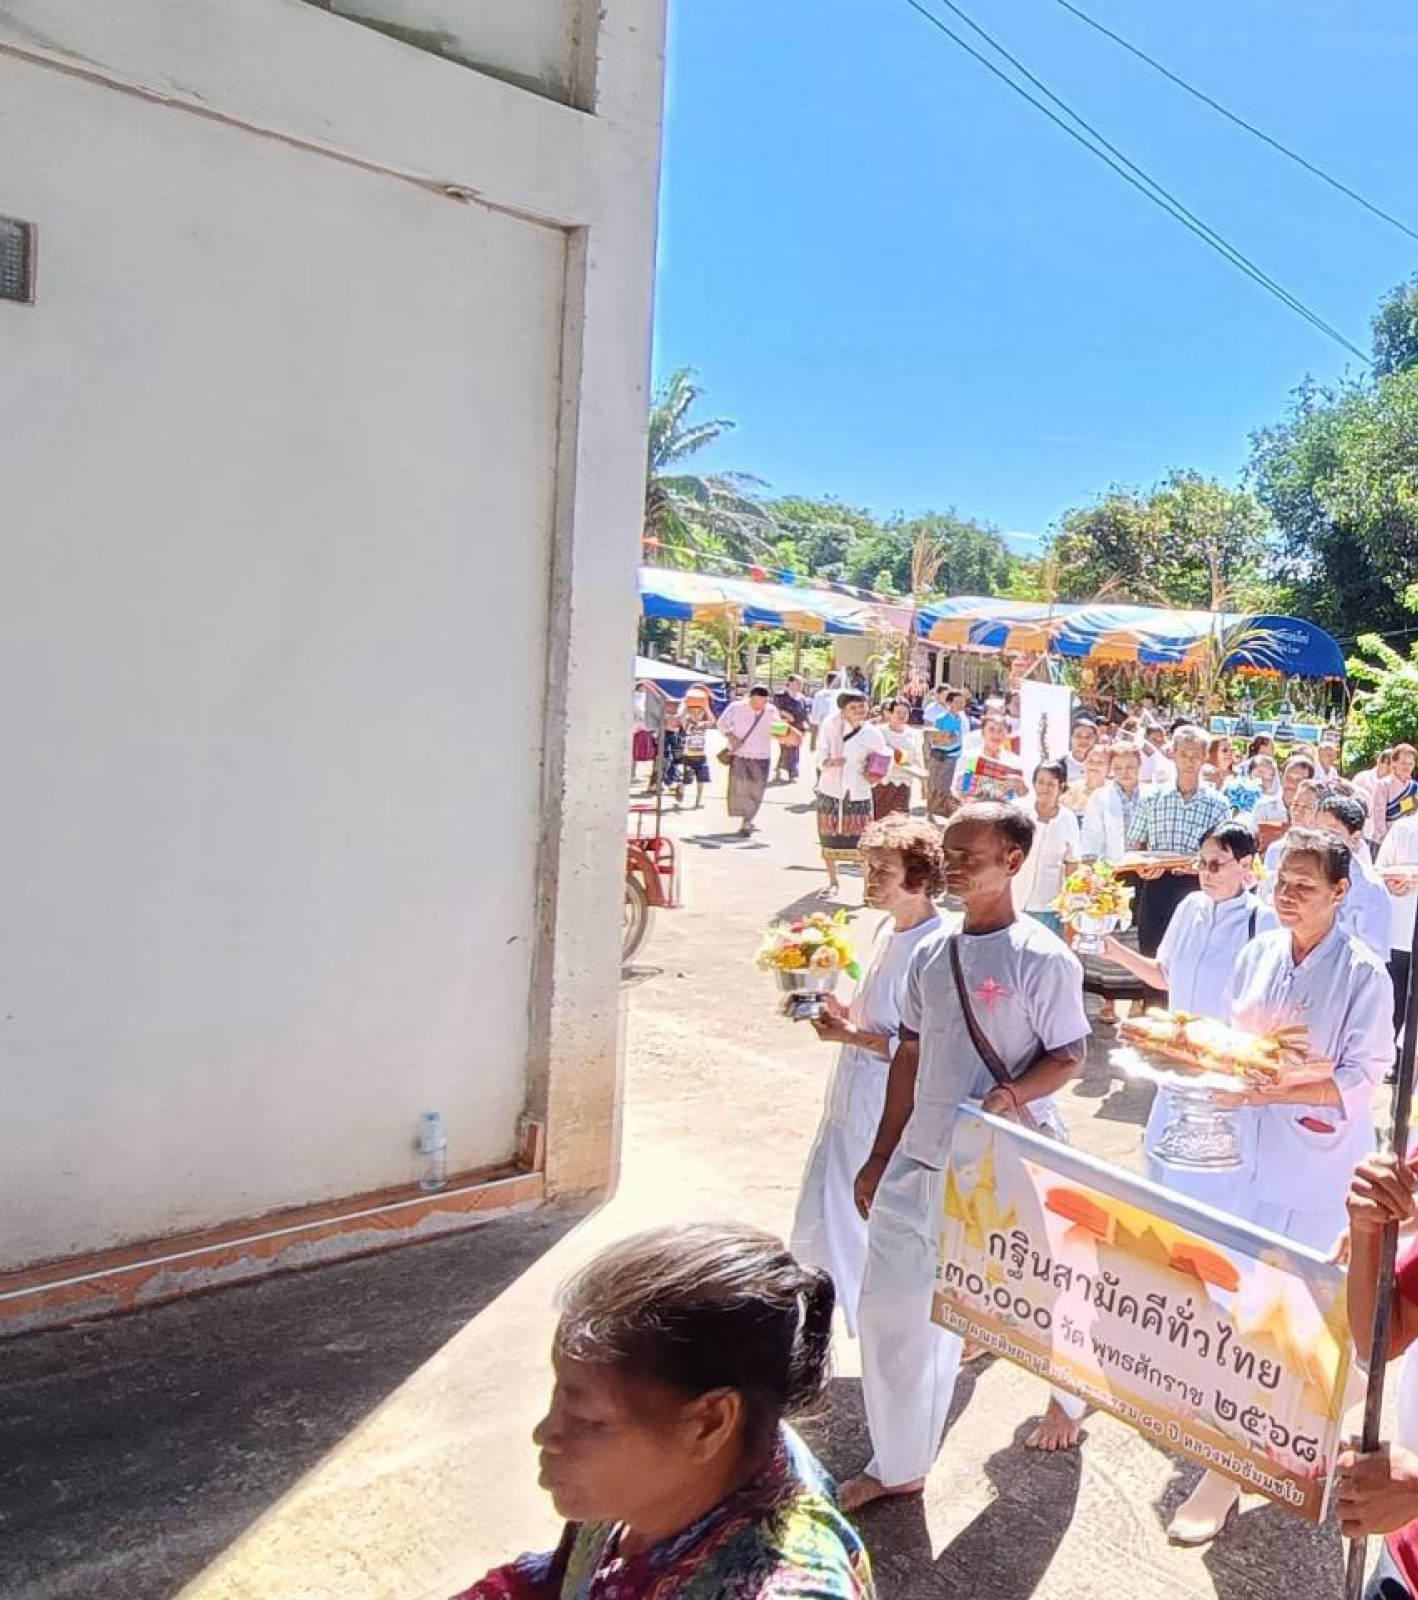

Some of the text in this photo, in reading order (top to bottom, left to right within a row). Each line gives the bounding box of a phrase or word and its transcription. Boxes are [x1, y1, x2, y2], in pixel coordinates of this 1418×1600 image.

[945, 1261, 1319, 1463] ๓๐,๐๐๐ วัด พุทธศักราช ๒๕๖๘
[988, 1229, 1282, 1390] กฐินสามัคคีทั่วไทย
